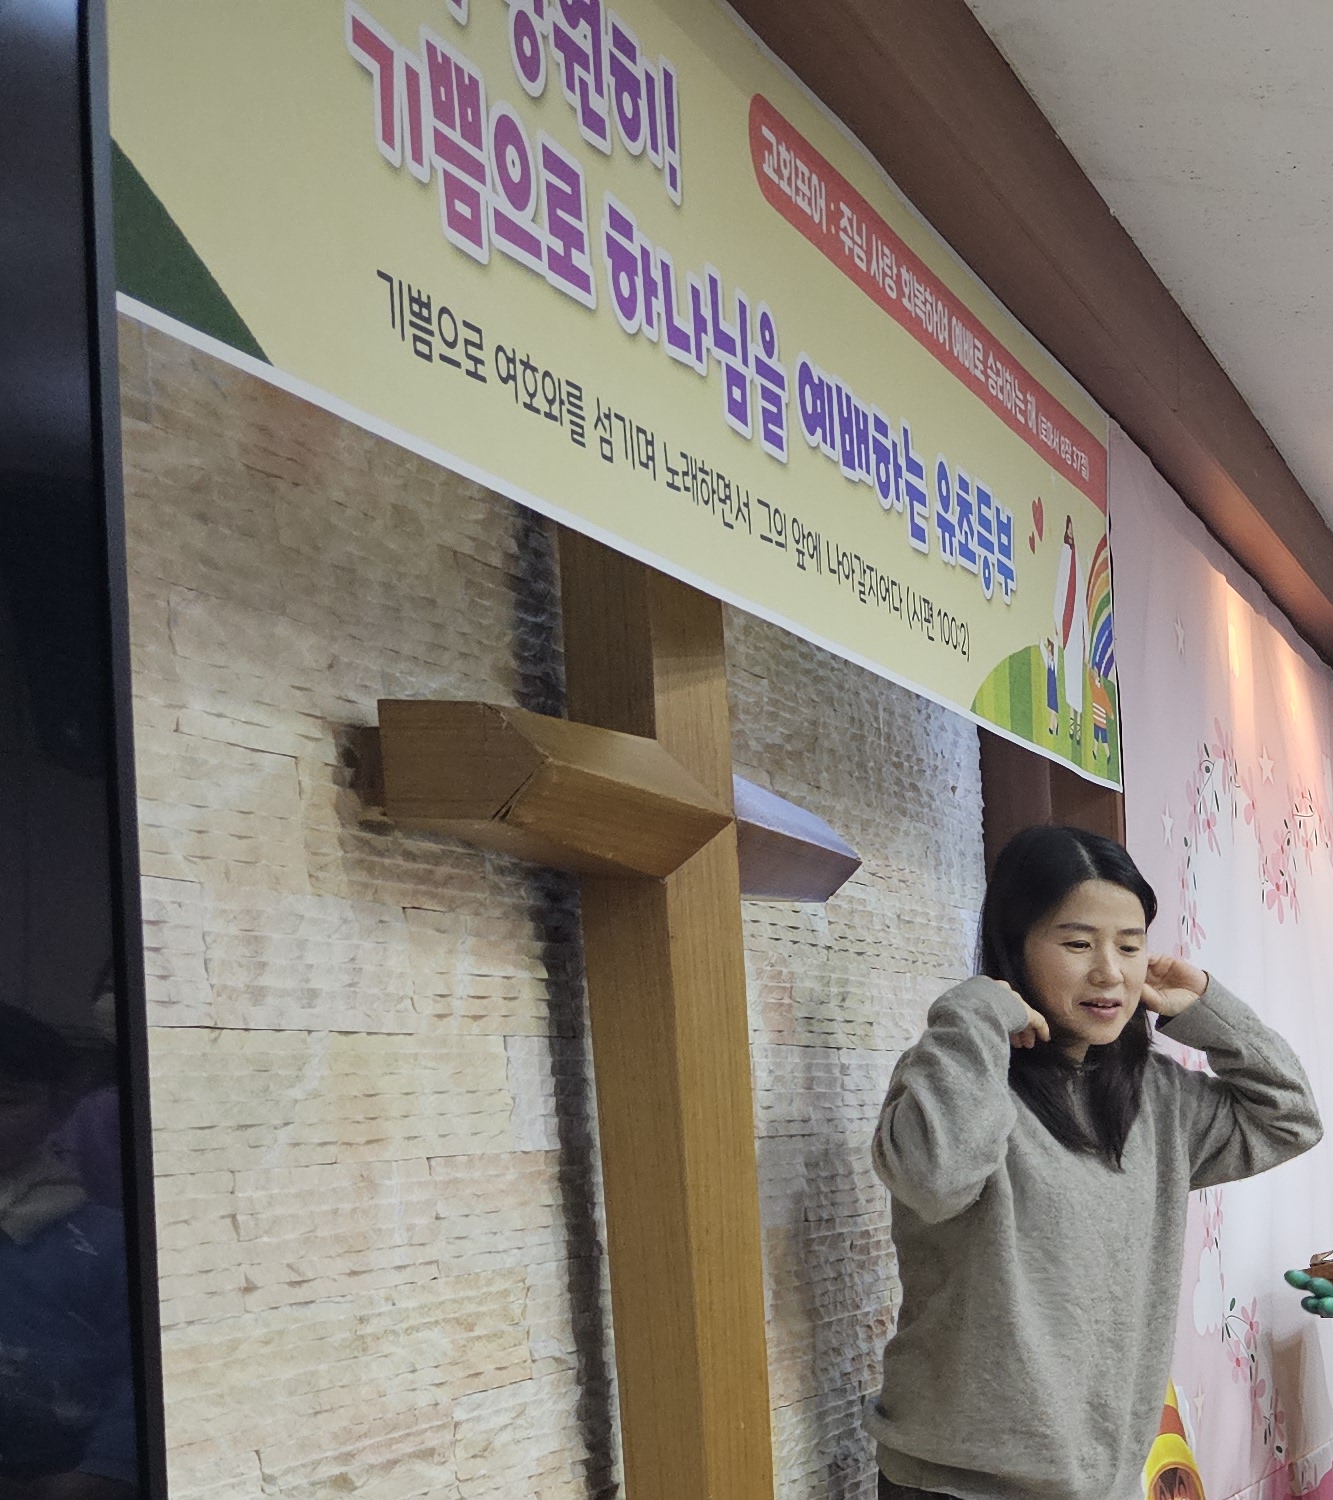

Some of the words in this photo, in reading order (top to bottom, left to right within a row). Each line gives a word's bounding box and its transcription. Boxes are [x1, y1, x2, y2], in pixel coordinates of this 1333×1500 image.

[510, 0, 681, 200] 원히!
[348, 8, 596, 303] 기쁨으로
[604, 196, 787, 457] 하나님을
[797, 356, 928, 549] 예배하는
[935, 457, 1015, 600] 유초등부
[761, 124, 827, 234] 교회표어
[839, 201, 867, 273] 주님
[870, 233, 898, 300] 사랑
[900, 265, 949, 351] 회복하여
[951, 315, 985, 383] 예배로
[987, 351, 1026, 425] 승리하는
[1026, 391, 1037, 434] 해
[376, 269, 487, 384] 기쁨으로
[495, 344, 587, 449] 여호와를
[593, 396, 657, 481] 섬기며
[663, 441, 752, 535] 노래하면서
[757, 498, 787, 552] 그의
[791, 517, 822, 575] 앞에
[827, 540, 903, 620] 나아갈지어다
[906, 585, 935, 642] (시편
[937, 608, 970, 662] 100:2)
